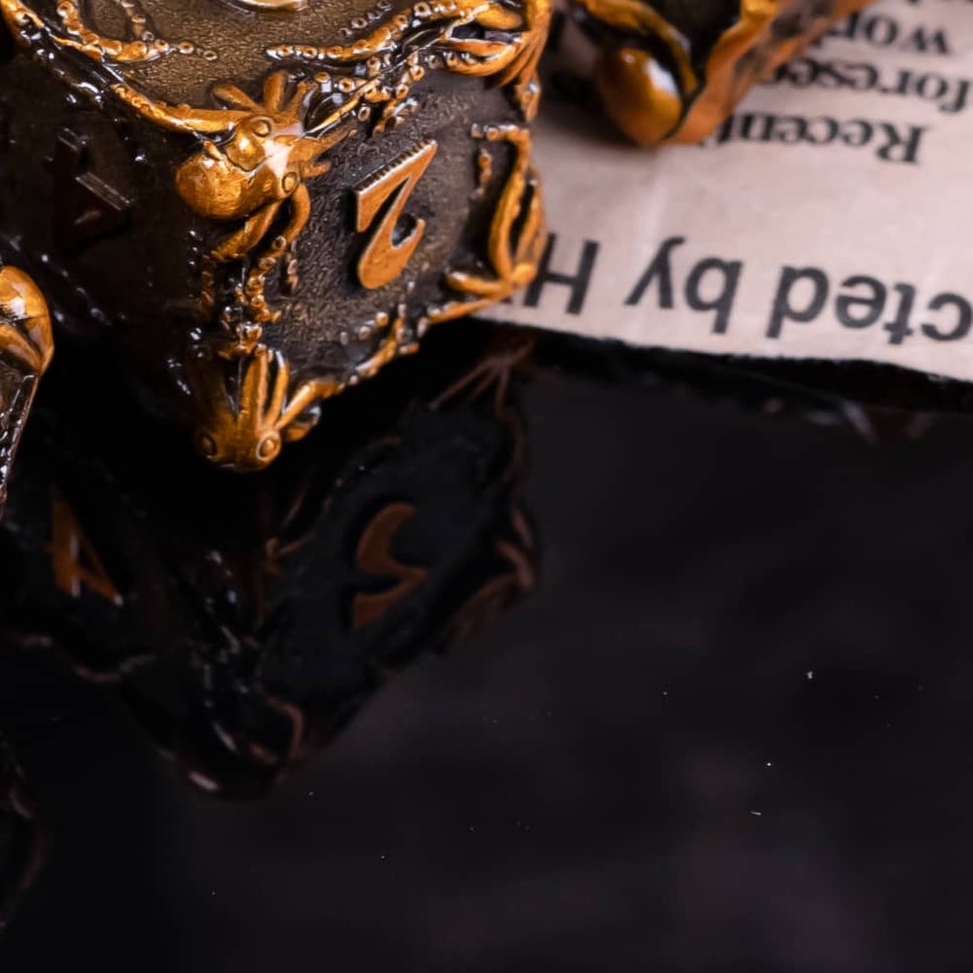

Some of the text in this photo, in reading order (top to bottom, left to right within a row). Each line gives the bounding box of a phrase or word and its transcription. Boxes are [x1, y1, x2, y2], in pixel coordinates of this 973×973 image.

[695, 111, 933, 169] Recent
[355, 138, 439, 291] 2
[511, 231, 602, 318] H
[621, 235, 744, 336] by
